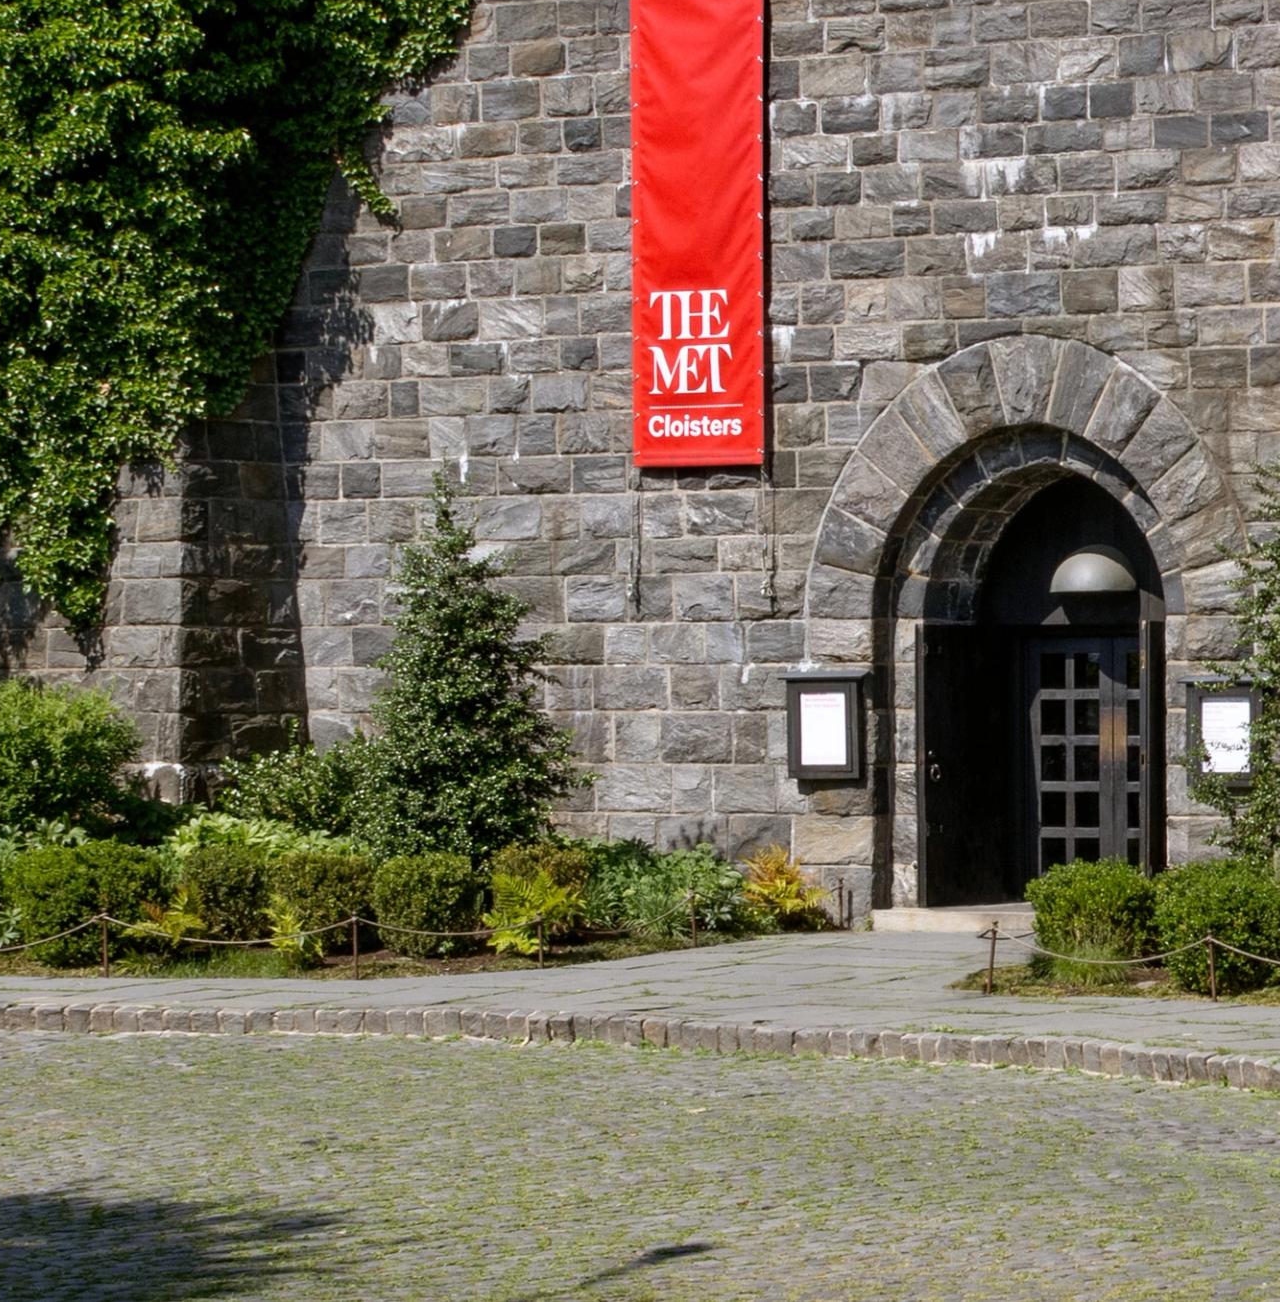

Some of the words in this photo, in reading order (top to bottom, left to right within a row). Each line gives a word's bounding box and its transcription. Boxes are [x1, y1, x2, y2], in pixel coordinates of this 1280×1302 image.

[649, 289, 730, 341] THE
[649, 344, 733, 395] MET
[648, 413, 743, 438] Cloisters
